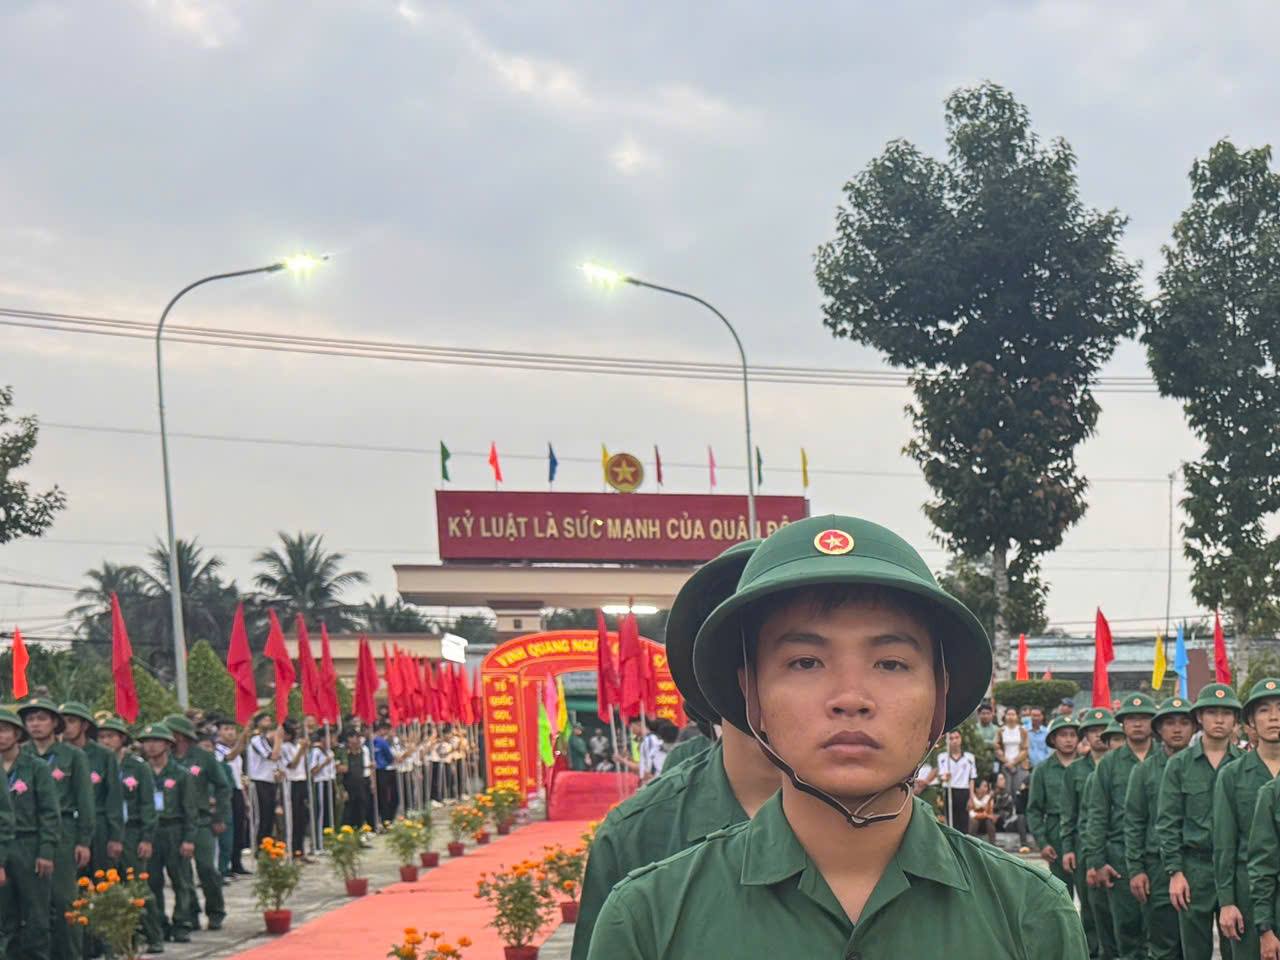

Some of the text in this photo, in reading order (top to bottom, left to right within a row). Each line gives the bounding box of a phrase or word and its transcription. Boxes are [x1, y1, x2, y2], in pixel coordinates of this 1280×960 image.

[448, 510, 473, 537] KỶ
[480, 512, 528, 541] LUẬT
[533, 511, 559, 537] LÀ
[563, 509, 602, 538] SỨC
[607, 517, 661, 542] MẠNH
[666, 512, 705, 539] CỦA
